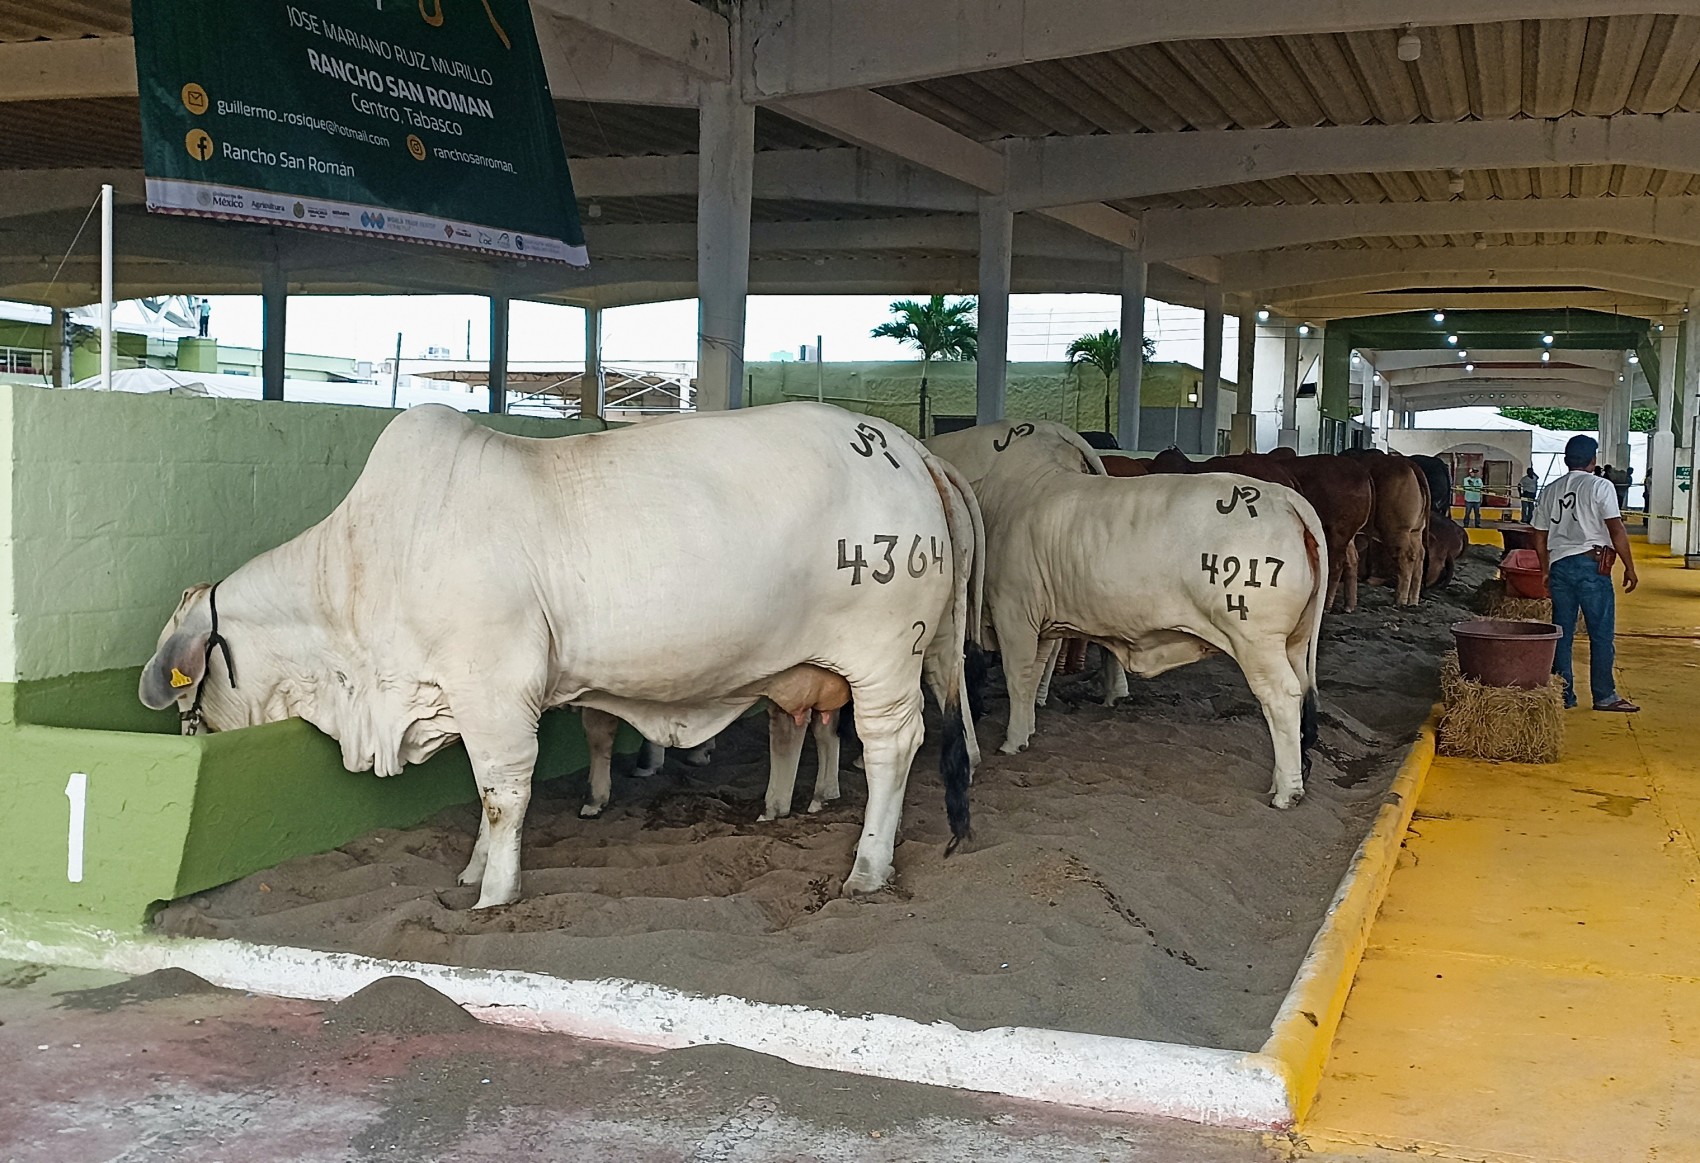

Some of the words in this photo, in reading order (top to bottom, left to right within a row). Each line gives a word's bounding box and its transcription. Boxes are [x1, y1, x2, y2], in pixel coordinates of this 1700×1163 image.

[286, 5, 321, 35] JOSE
[323, 19, 392, 60] MARIANO
[393, 45, 430, 71] RUIZ
[431, 56, 493, 86] MURILLO
[307, 48, 384, 93] RANCHO
[386, 76, 426, 104] SAN
[425, 86, 494, 119] ROMAN
[217, 100, 390, 148] guillermo_rosique@hotmail.com
[403, 107, 463, 136] Tabasco
[222, 142, 277, 166] Rancho
[280, 152, 305, 170] San
[308, 157, 355, 177] Román
[433, 147, 518, 175] ranchosanroman_
[212, 197, 244, 209] México
[836, 533, 945, 586] 4364
[1201, 552, 1286, 589] 4917
[1225, 593, 1250, 621] 4
[911, 620, 927, 656] 2
[64, 772, 88, 883] 1
